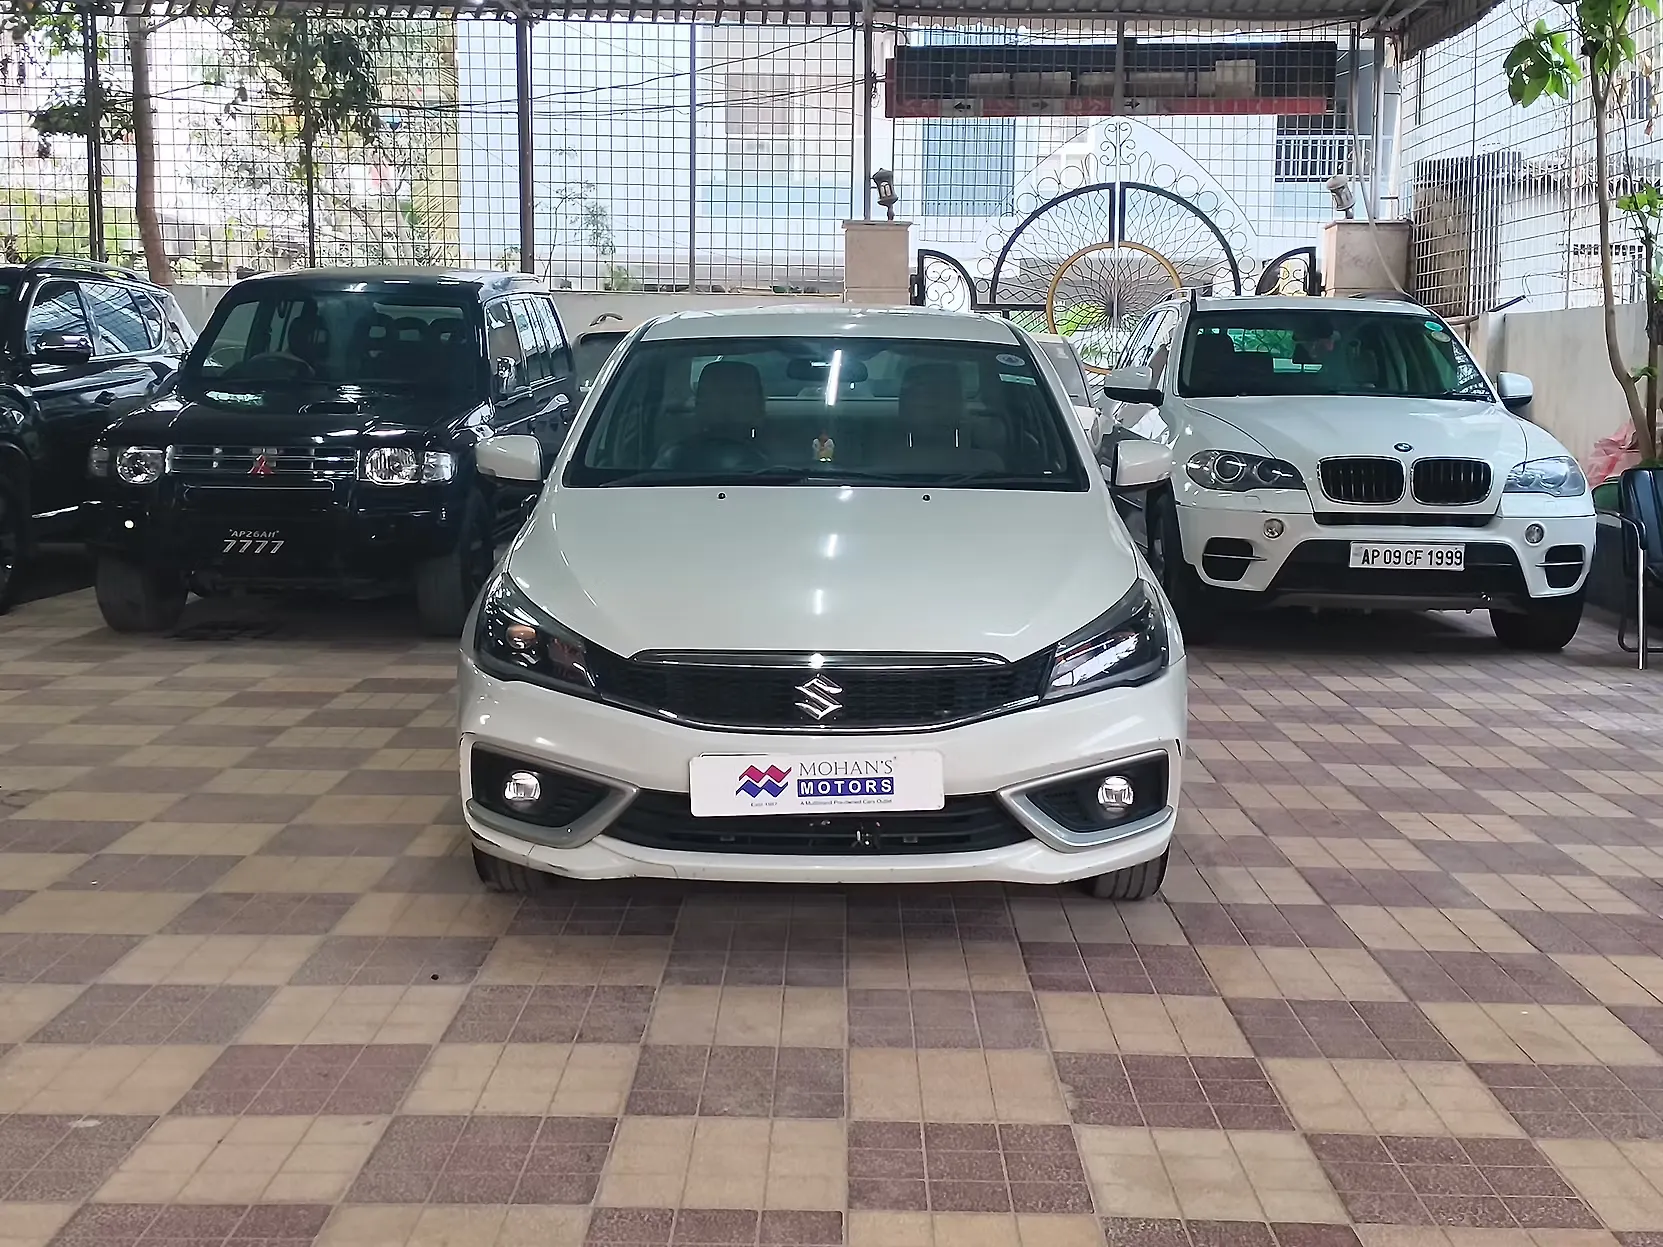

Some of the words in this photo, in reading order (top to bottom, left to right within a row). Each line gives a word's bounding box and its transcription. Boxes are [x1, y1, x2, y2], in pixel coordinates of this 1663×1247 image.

[223, 539, 285, 554] 7777
[1361, 548, 1381, 565] AP
[1383, 549, 1402, 565] 09
[1404, 549, 1424, 566] CF
[1427, 550, 1463, 566] 1999
[799, 759, 893, 776] MOHAN'S
[800, 779, 892, 795] MOTORS
